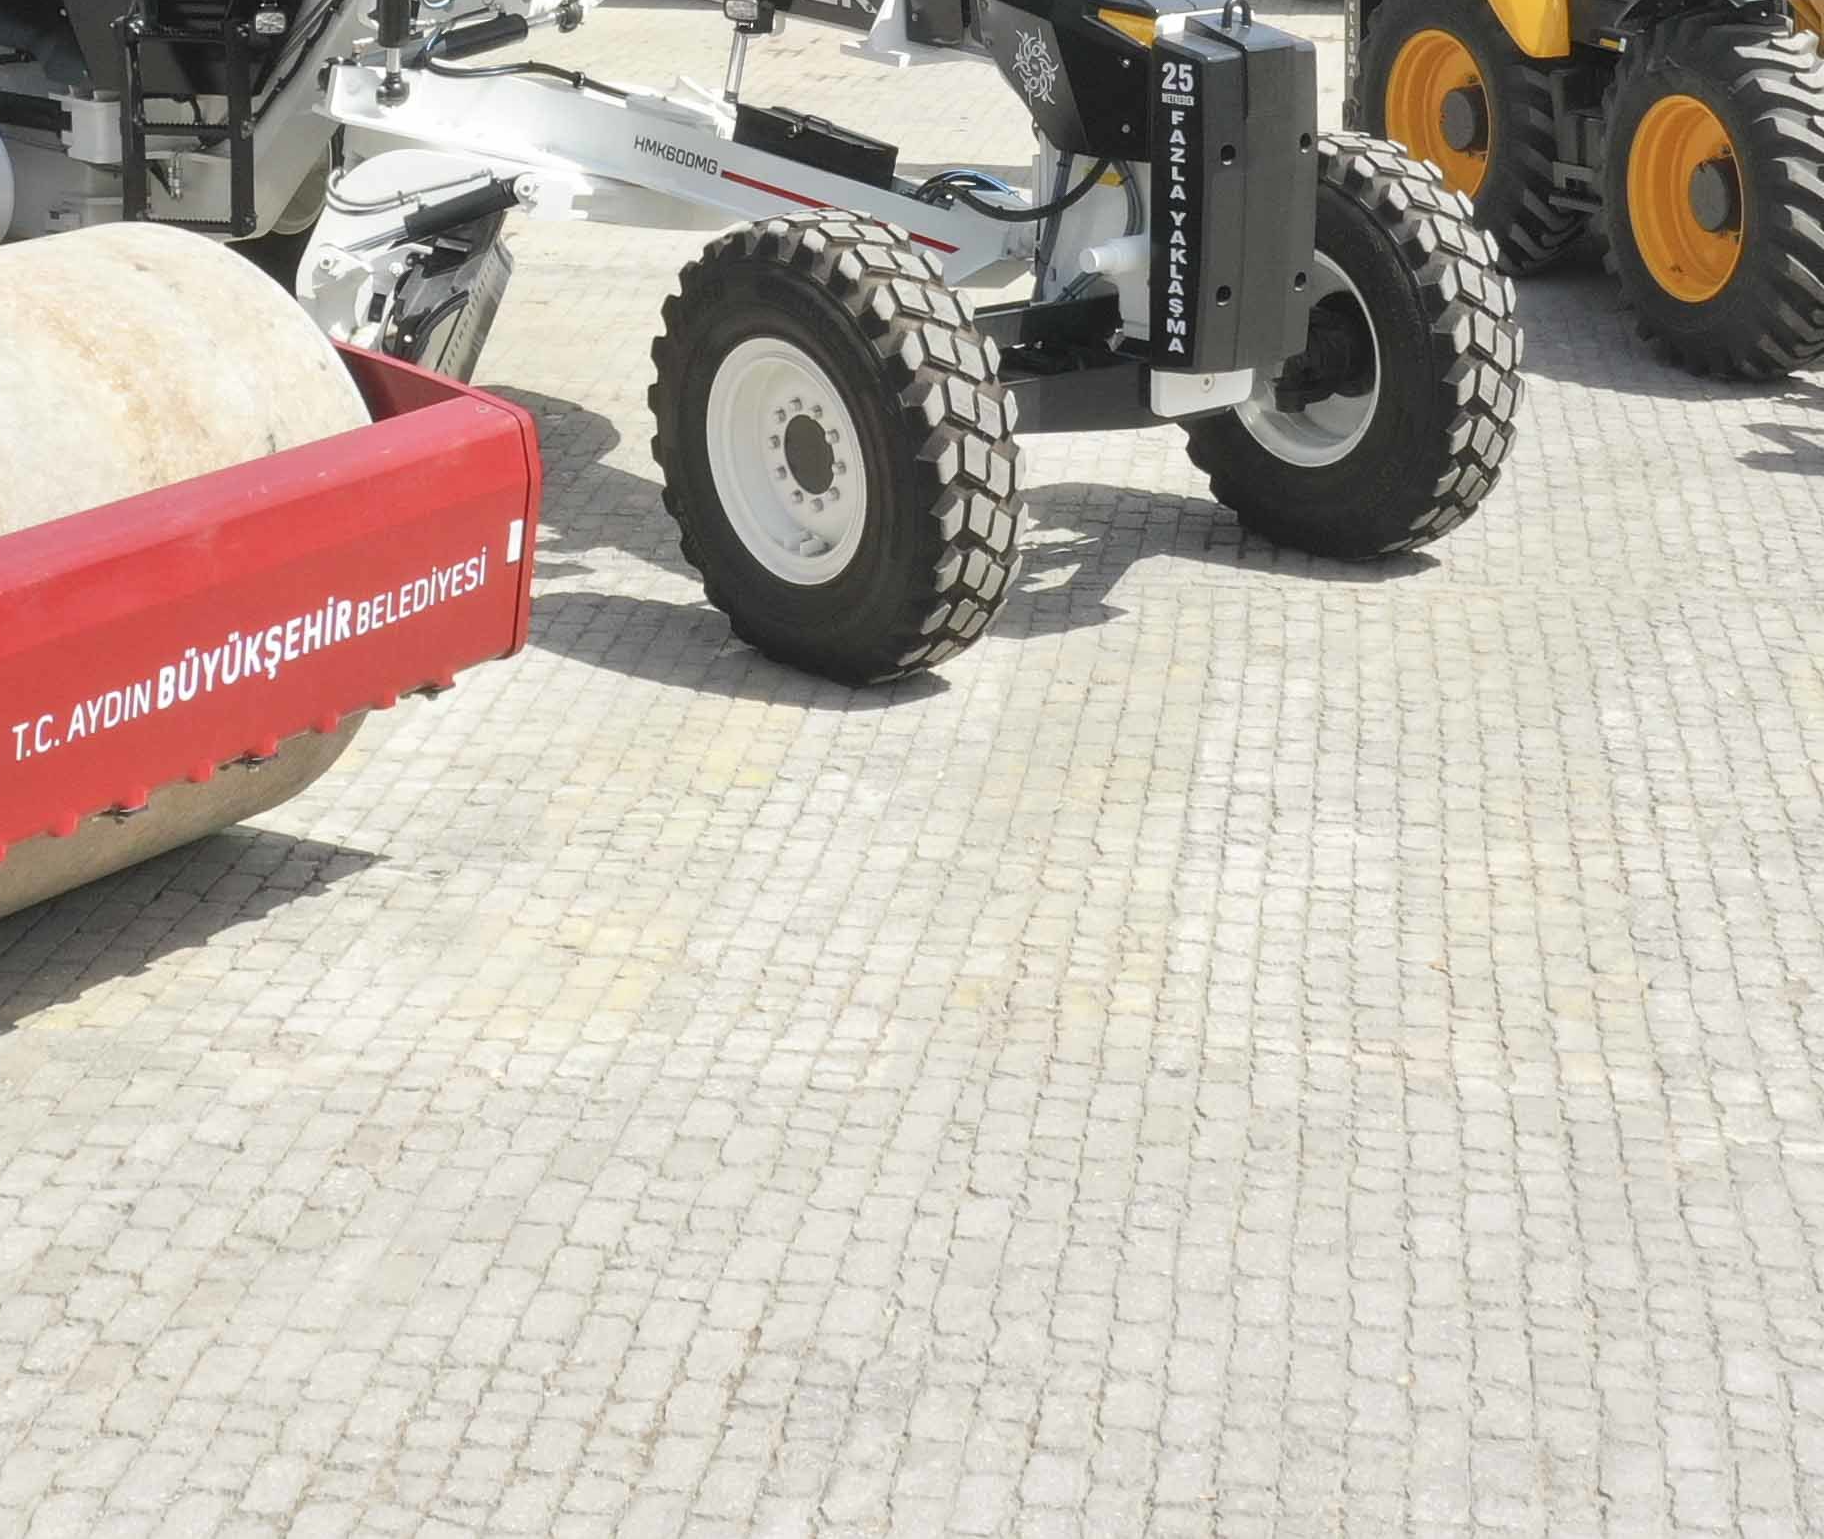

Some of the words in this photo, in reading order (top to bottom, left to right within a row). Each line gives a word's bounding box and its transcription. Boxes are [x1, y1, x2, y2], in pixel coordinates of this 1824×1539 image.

[1161, 61, 1194, 92] 25
[634, 135, 718, 175] HMK600MG
[1169, 110, 1186, 200] FAZLA
[1166, 211, 1188, 354] YAKLAŞMA
[12, 714, 61, 761] T.C.
[66, 679, 153, 743] AYDIN
[156, 596, 353, 711] BÜYÜKŞEHİR
[356, 547, 487, 636] BELEDİYESİ
